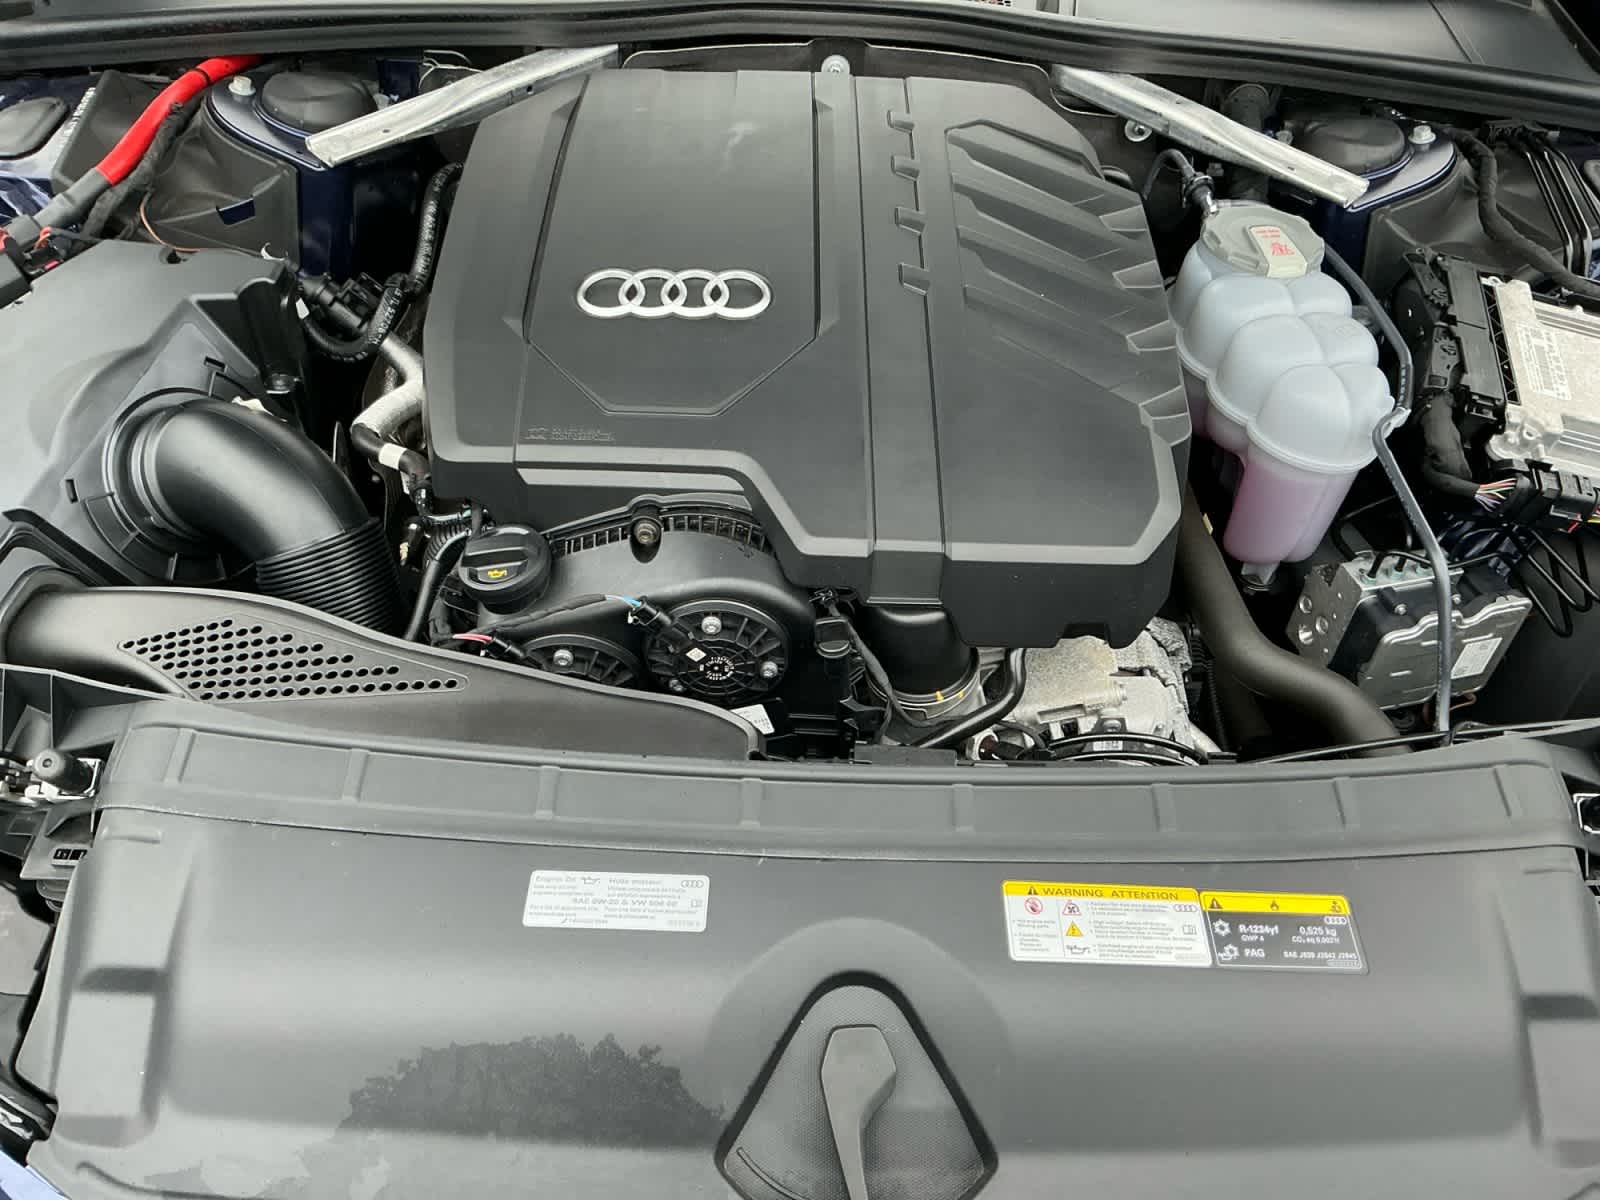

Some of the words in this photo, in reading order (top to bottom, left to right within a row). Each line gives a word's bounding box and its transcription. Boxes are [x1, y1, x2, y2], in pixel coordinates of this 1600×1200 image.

[1042, 887, 1104, 898] WARNING
[1111, 889, 1179, 900] ATTENTION
[1325, 927, 1337, 937] kg
[1244, 948, 1265, 958] PAG
